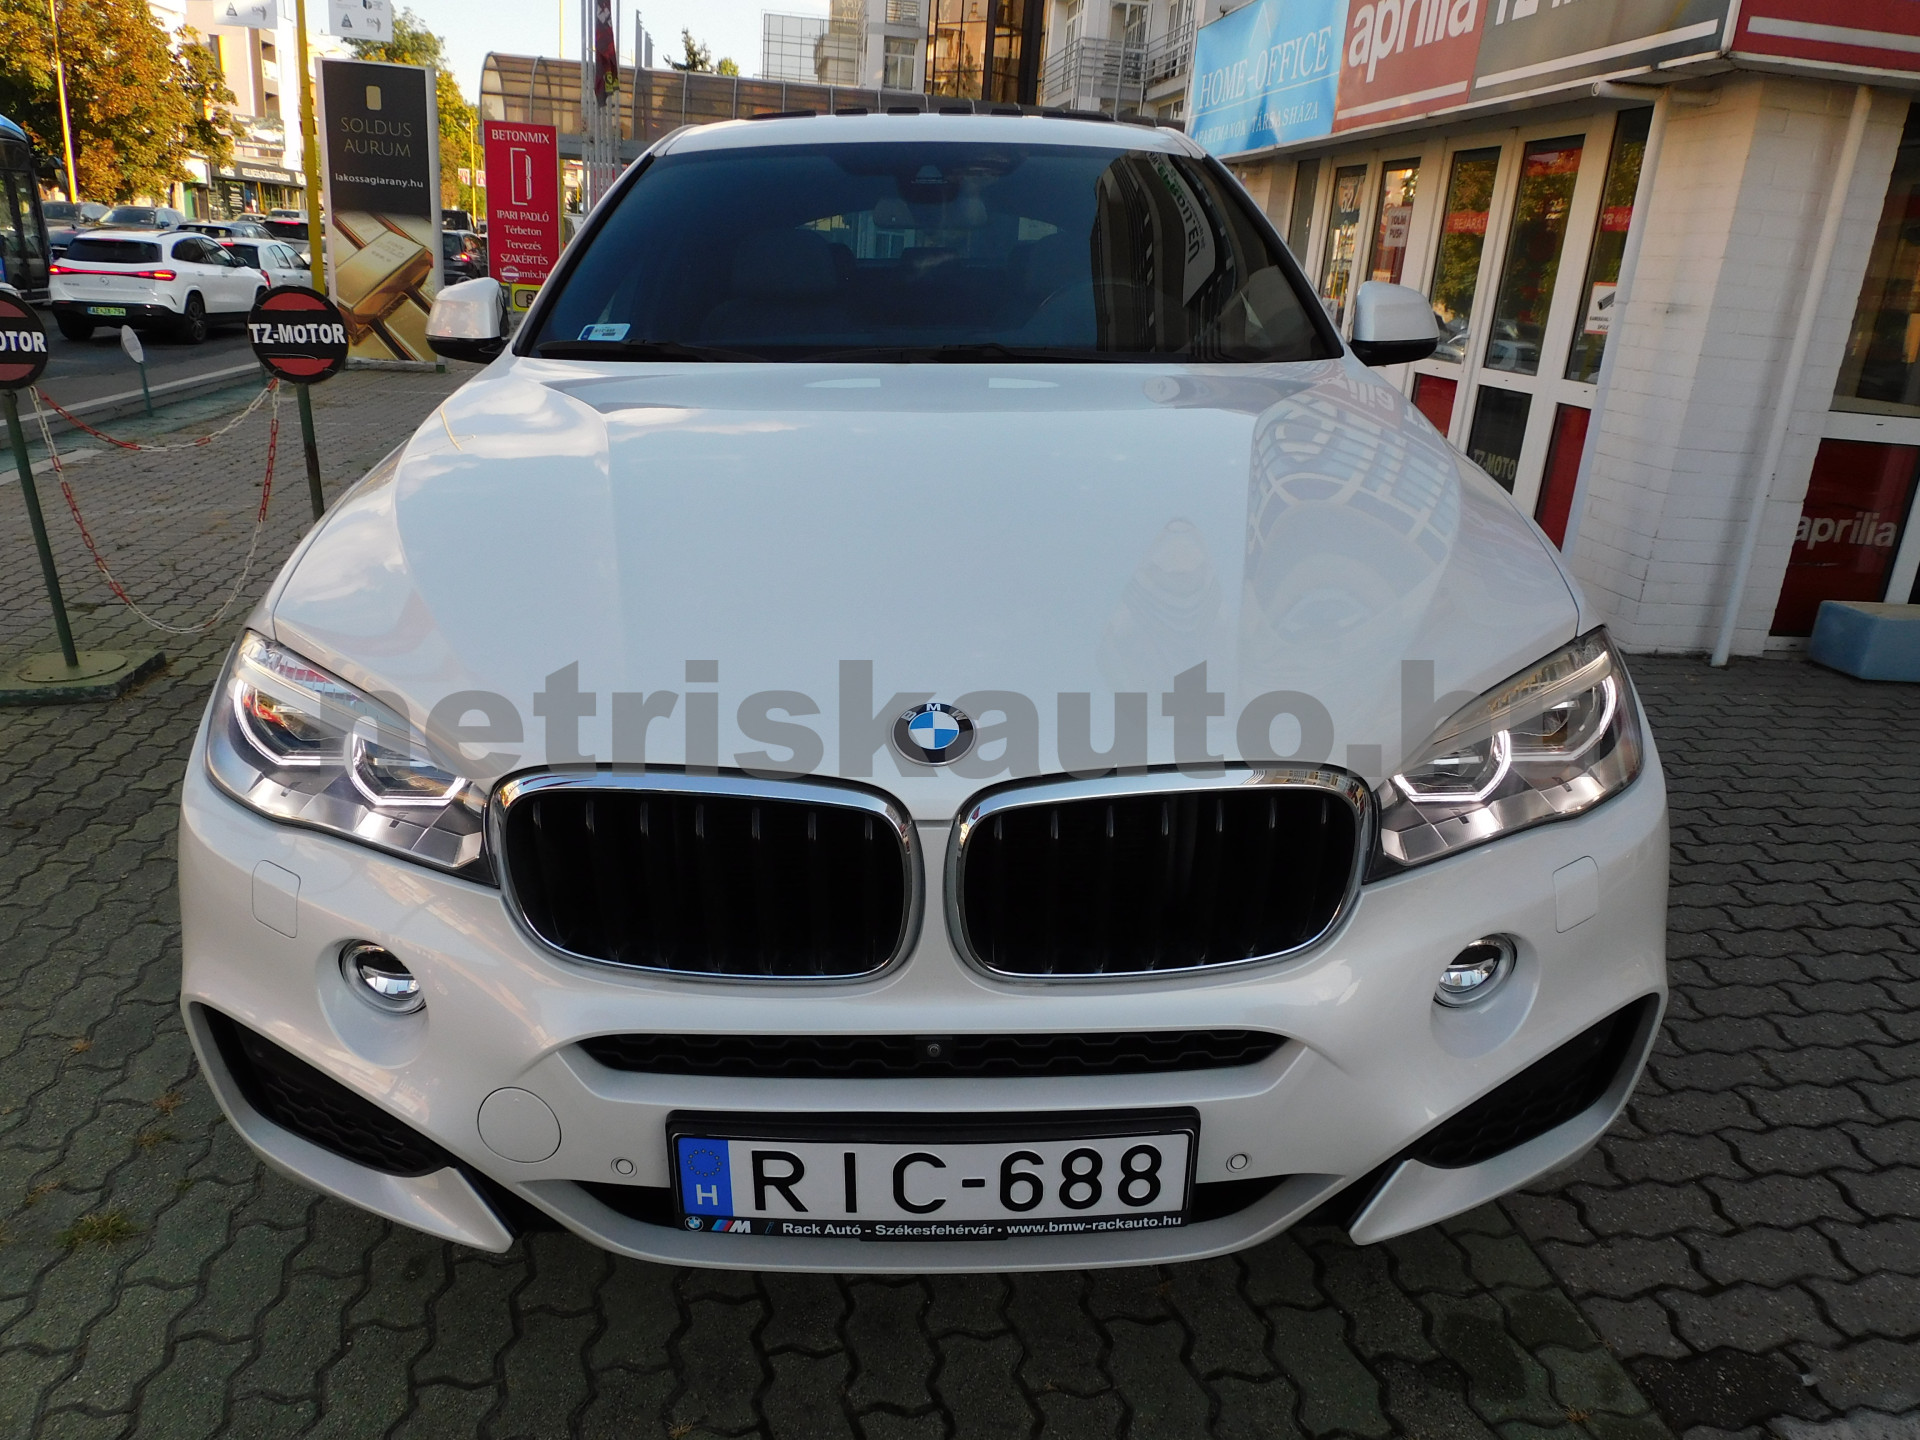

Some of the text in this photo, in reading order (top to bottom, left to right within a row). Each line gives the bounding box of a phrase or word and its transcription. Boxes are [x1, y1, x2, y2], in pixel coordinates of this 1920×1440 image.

[1199, 26, 1332, 109] HOME-OFFICE
[341, 116, 412, 138] SOLDUS
[491, 129, 550, 144] BETONMIX
[344, 138, 411, 158] AURUM
[335, 173, 424, 189] lakossagiarany.hu
[496, 210, 550, 223] IPARI PADLÓ
[504, 224, 542, 236] Térbeton
[505, 239, 542, 250] Tervezés
[500, 252, 549, 265] SZAKÉRTÉS
[248, 323, 347, 344] TZ-MOTOR
[1795, 511, 1898, 551] aprilia
[901, 703, 969, 721] BMW
[750, 1144, 1163, 1214] RIC-688
[696, 1184, 718, 1206] H
[782, 1222, 822, 1235] Rack
[824, 1221, 862, 1236] Autó
[875, 1222, 994, 1236] Székesfehérvár
[1006, 1215, 1182, 1234] www.bmw-rackauto.hu
